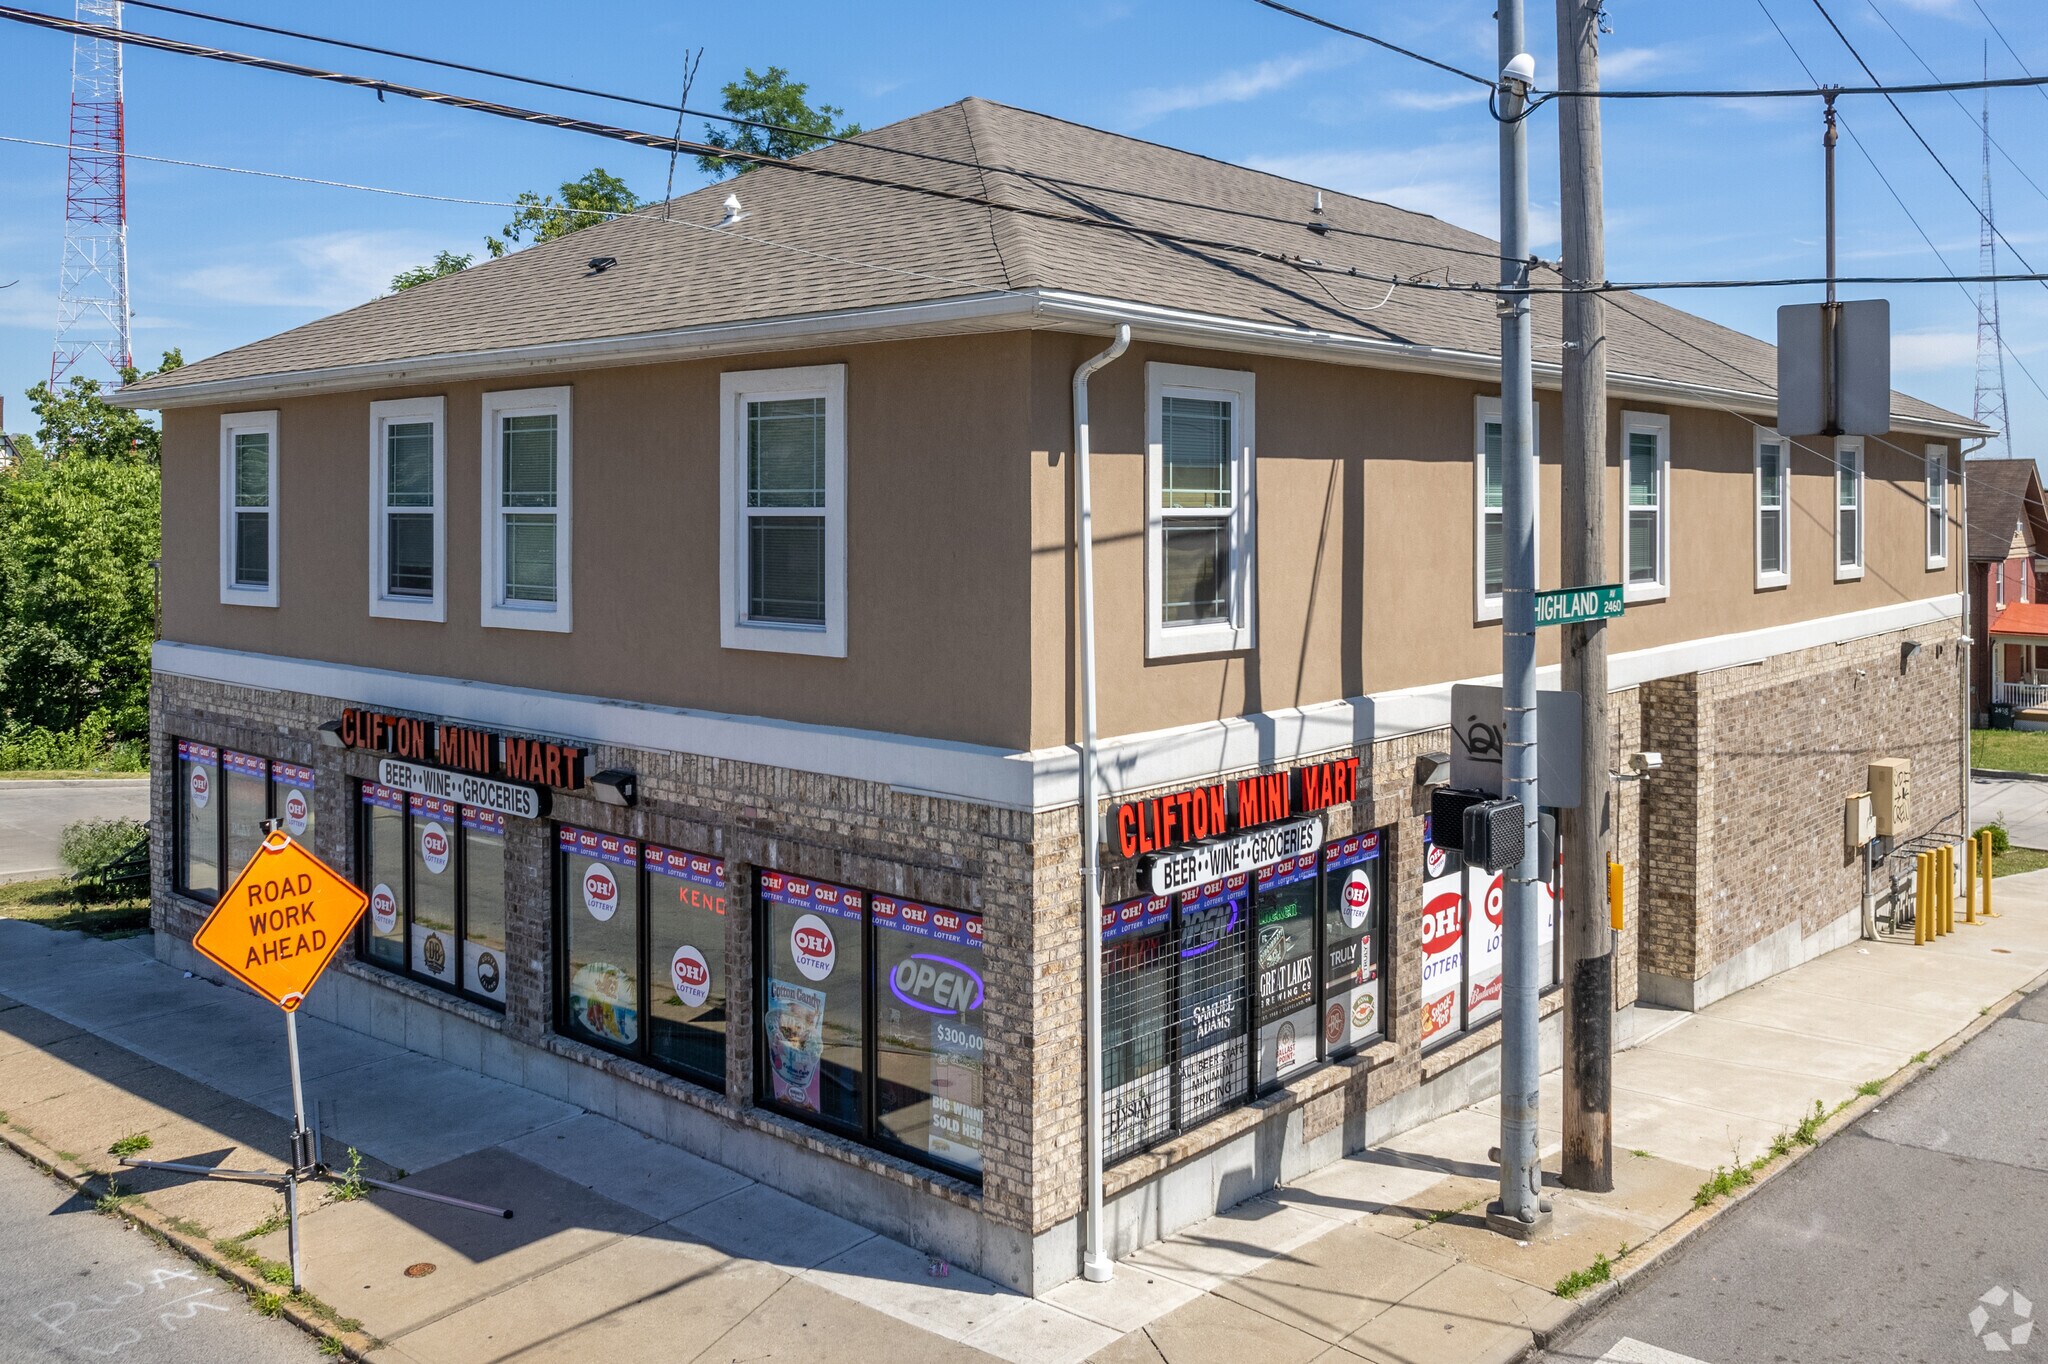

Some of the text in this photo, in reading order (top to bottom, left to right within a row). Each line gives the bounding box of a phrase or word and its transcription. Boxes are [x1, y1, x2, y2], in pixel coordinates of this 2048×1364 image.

[1609, 589, 1616, 598] AV
[1535, 592, 1598, 621] HIGHLAND
[1604, 600, 1622, 614] 2460
[342, 708, 578, 790] CLIFTON MINI MART
[193, 778, 207, 790] OH!
[386, 762, 530, 814] BEER WINE GROCERIES
[288, 802, 304, 815] OH!
[393, 793, 402, 802] OH
[426, 800, 440, 810] OH!
[443, 804, 454, 813] OH
[462, 808, 476, 818] OH!
[480, 812, 494, 822] OH!
[1118, 757, 1359, 858] CLIFTON MINI MART
[288, 819, 305, 828] LOTTERY
[424, 837, 445, 852] OH!
[560, 830, 710, 873] OH! OH! OH! OH OH! OH! OH!
[1344, 841, 1358, 854] OH!
[1362, 835, 1376, 848] OH!
[425, 855, 446, 865] LOTTERY
[560, 844, 577, 852] LOTTERY
[581, 849, 598, 858] LOTTERY
[602, 854, 620, 862] LOTTERY
[624, 858, 636, 866] LOTTE
[645, 863, 664, 873] LOTTERY
[668, 869, 687, 879] LOTTERY
[691, 875, 712, 885] LOTTERY
[1164, 824, 1314, 890] BEER WINE GROCERIES
[1278, 860, 1294, 873] OH!
[1299, 854, 1315, 867] OH!
[248, 874, 312, 907] ROAD
[587, 879, 612, 896] OH!
[1204, 880, 1222, 895] OH!
[1227, 874, 1245, 888] OH!
[1346, 888, 1367, 902] OH!
[374, 898, 394, 912] OH!
[588, 899, 613, 912] LOTTERY
[761, 876, 983, 934] OH! OH! OH! OH OH! OH! OH! OH
[1121, 903, 1142, 920] OH!
[1147, 896, 1167, 912] OH!
[1182, 890, 1246, 914] OTTERY LOTTERY LOTTERY
[250, 900, 316, 936] WORK
[375, 914, 394, 925] LOTTERY
[761, 891, 983, 946] LOTTERY LOTTERY LOTTERY LOTTE LOTTERY LOTTERY LOTTERY LOTT
[1121, 913, 1168, 933] LOTTERY LOTTERY
[1343, 908, 1365, 918] LOTTERY
[245, 930, 326, 970] AHEAD
[796, 933, 829, 952] OH!
[797, 956, 829, 971] LOTTERY
[1330, 944, 1357, 966] TRULY
[676, 962, 704, 981] OH!
[1260, 966, 1286, 998] GREAT
[1288, 955, 1312, 987] LAKES
[677, 983, 706, 998] LOTTERY
[771, 982, 796, 1000] Cotton
[896, 960, 974, 1012] OPEN
[1260, 986, 1298, 1009] BREWING
[1192, 994, 1235, 1026] SAMUEL
[1438, 1010, 1449, 1028] TOP
[937, 1024, 983, 1050] $300,00
[1196, 1013, 1231, 1042] ADAMS
[1181, 1042, 1244, 1080] ALL BEER STATE
[1278, 1052, 1293, 1064] POINT
[1192, 1064, 1233, 1091] MINIMUM
[932, 1094, 950, 1111] BIG
[1193, 1082, 1232, 1108] PRICING
[932, 1114, 960, 1132] SOLD
[1110, 1097, 1152, 1134] ELYSIAN
